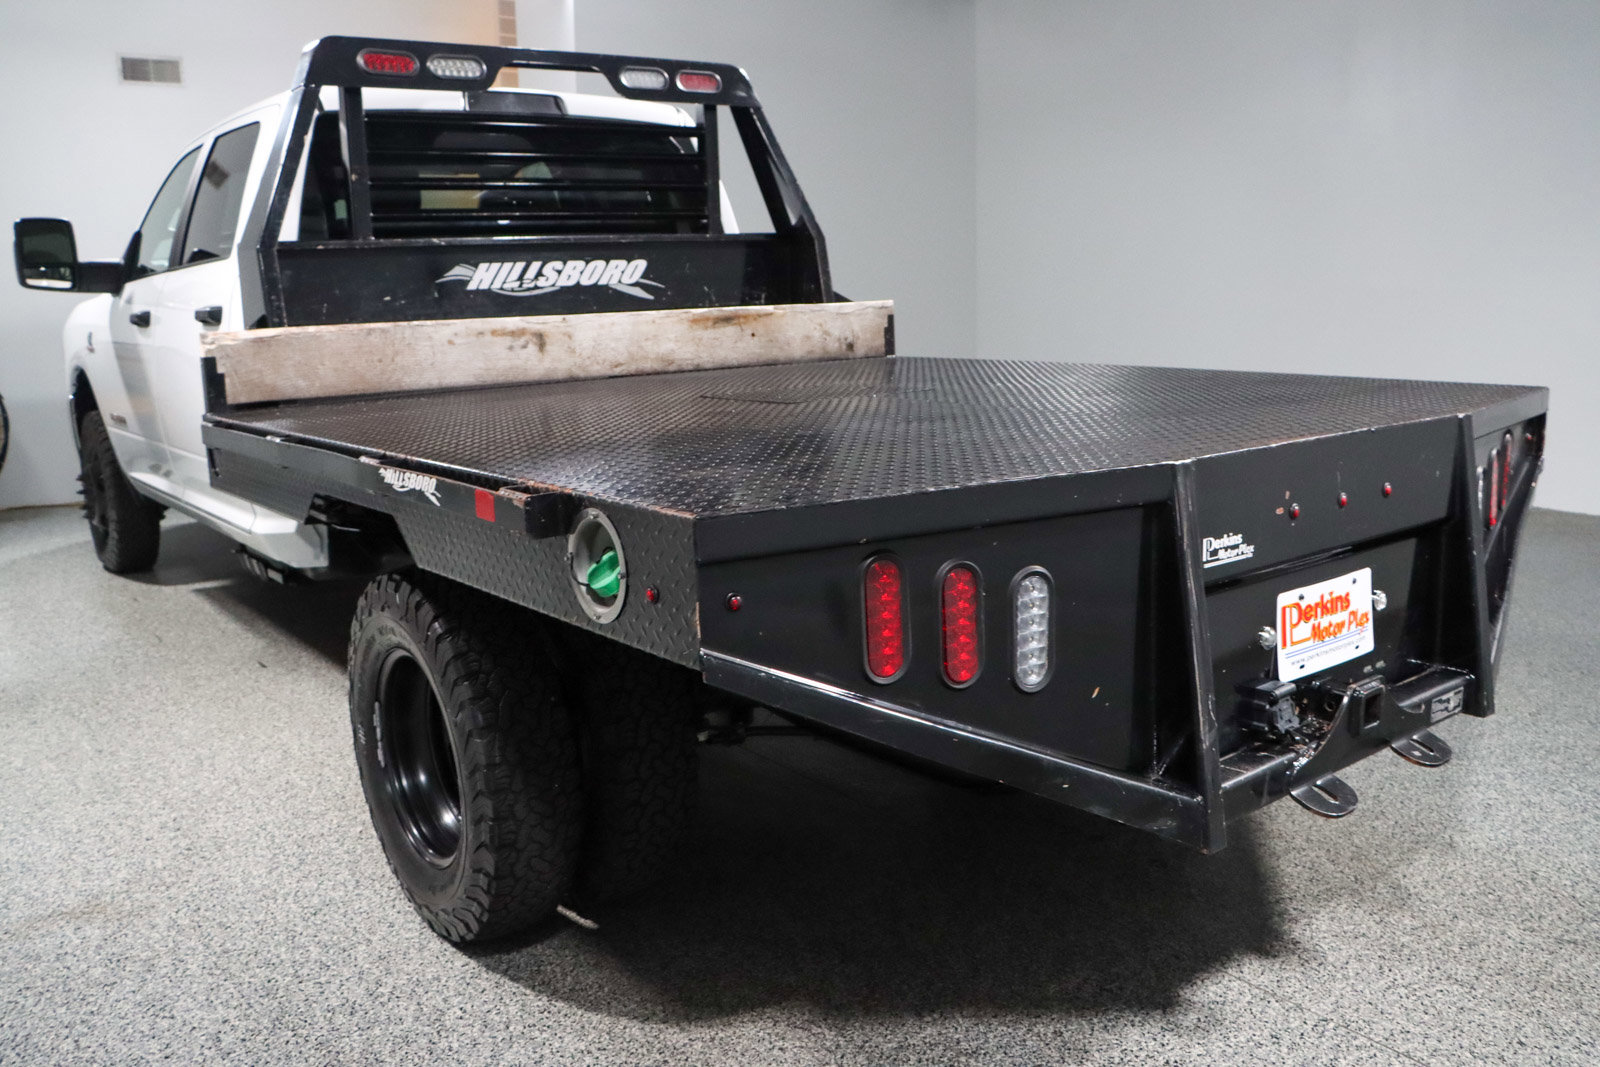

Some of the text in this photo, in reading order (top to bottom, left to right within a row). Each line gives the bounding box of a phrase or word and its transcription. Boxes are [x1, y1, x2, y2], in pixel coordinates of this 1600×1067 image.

[466, 259, 647, 290] HILLSBORO
[384, 467, 437, 494] HILLSBORO
[1281, 591, 1351, 649] Perkins
[1311, 620, 1346, 643] Motor
